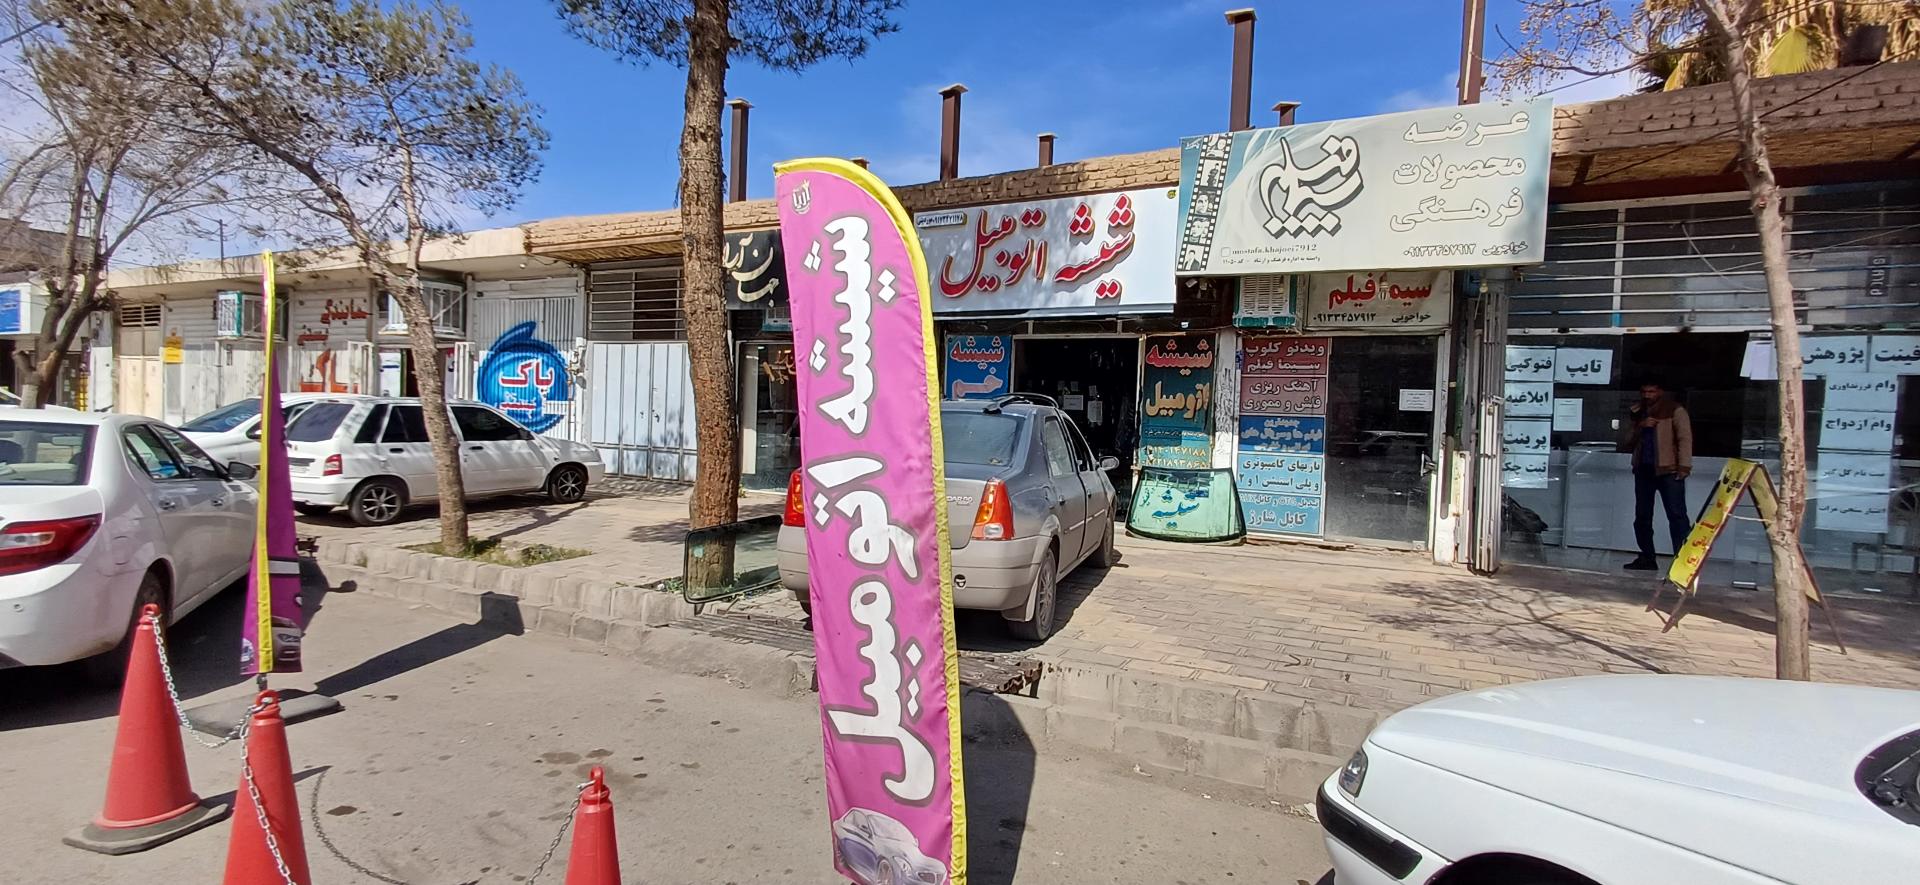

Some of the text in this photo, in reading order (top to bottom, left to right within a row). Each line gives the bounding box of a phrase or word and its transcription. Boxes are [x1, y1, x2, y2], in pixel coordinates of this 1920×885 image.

[1403, 111, 1530, 146] عرضه
[1393, 153, 1526, 189] محصولات
[1390, 187, 1524, 232] فرهنگی
[939, 193, 1136, 300] شیشه اتومبیل
[1328, 272, 1377, 311] فیلم
[1312, 312, 1377, 322] ۰۹۱۳۳۴۵۷۹۱۲
[950, 335, 1005, 370] شیشه
[1145, 338, 1213, 376] شیشه
[1801, 346, 1864, 364] پژوهش
[1247, 358, 1274, 373] فیلم
[1504, 355, 1553, 374] فتوکپی
[1565, 359, 1602, 378] تایپ
[1250, 379, 1280, 395] ریزی
[1875, 380, 1896, 392] وام
[1145, 380, 1210, 419] اتومبیل
[1284, 400, 1291, 412] و
[1505, 390, 1549, 407] ابلاغیه
[1824, 417, 1893, 431] وام ازدواج
[1248, 478, 1254, 487] و
[1314, 483, 1319, 491] و
[804, 216, 937, 803] شیشه اتومبیل
[1280, 511, 1307, 527] کابل
